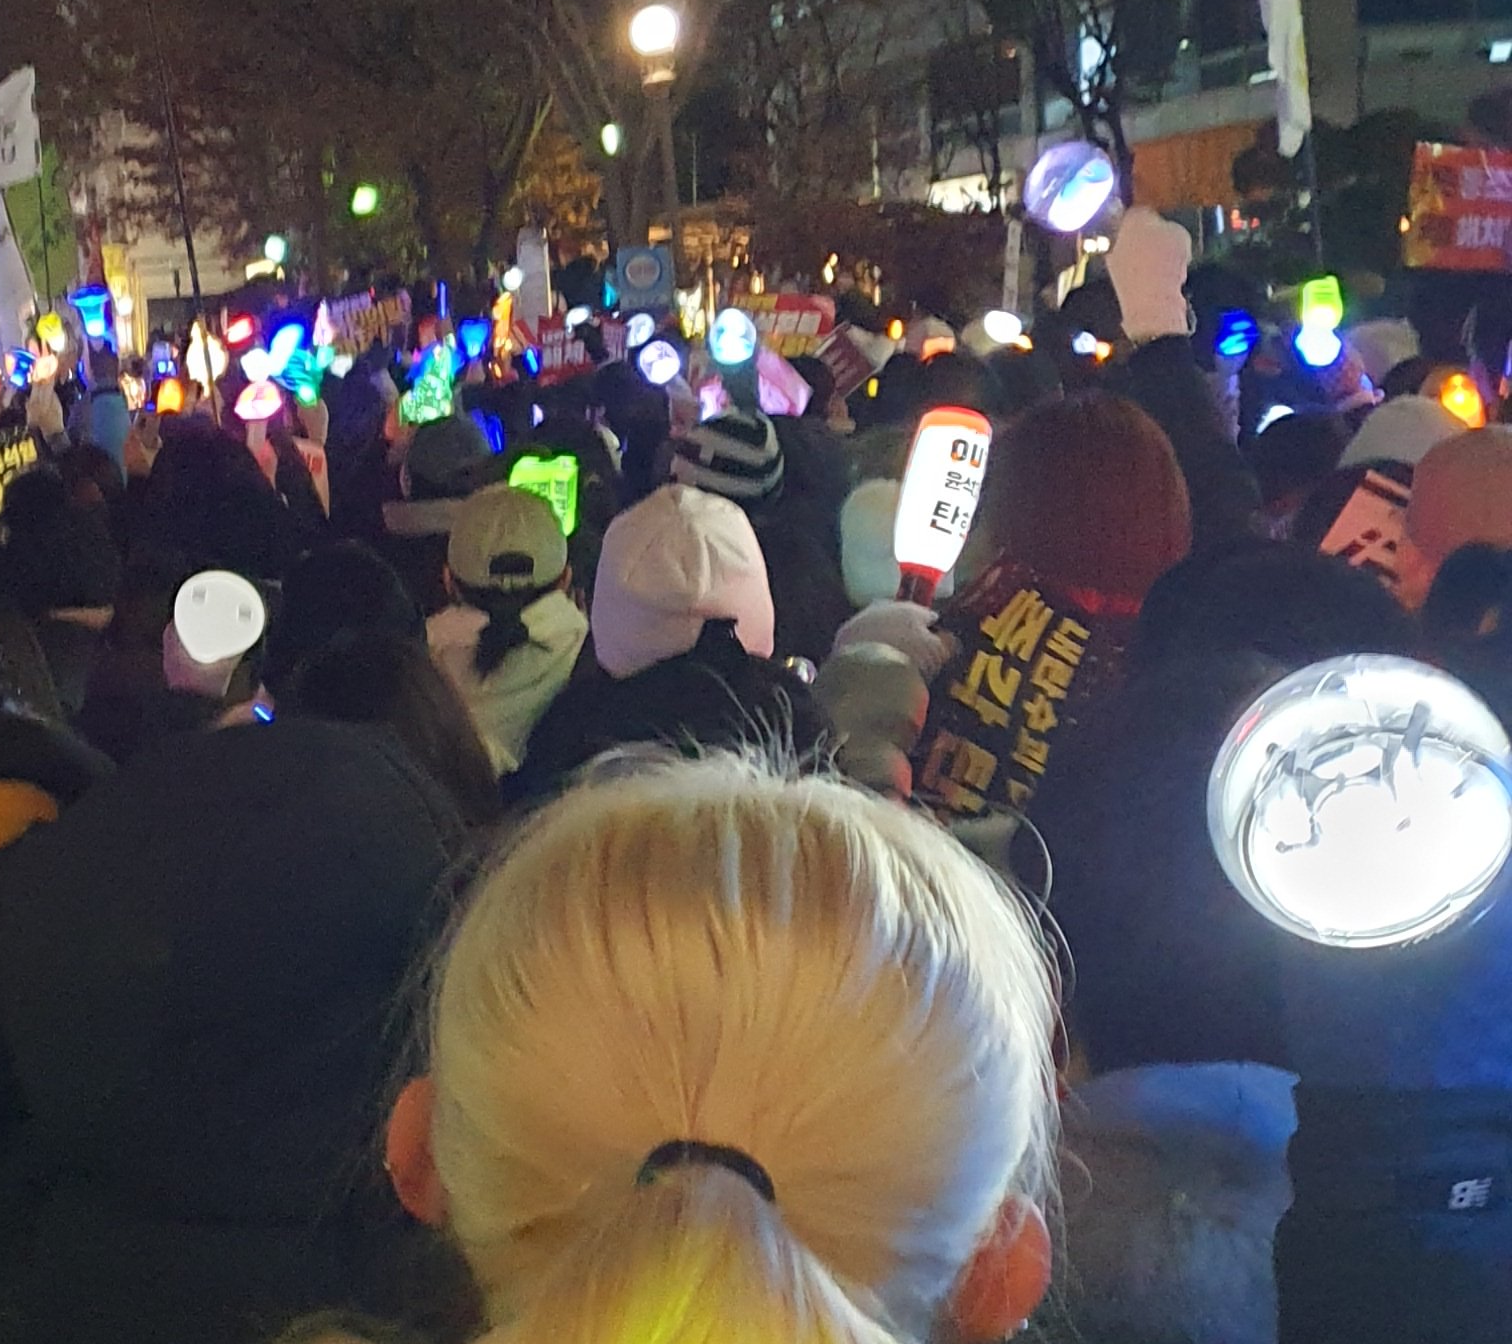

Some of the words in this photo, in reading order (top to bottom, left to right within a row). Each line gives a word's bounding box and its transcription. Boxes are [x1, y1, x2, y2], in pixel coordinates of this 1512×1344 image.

[951, 438, 986, 468] OU
[944, 471, 979, 497] 윤석
[920, 728, 999, 815] 탄
